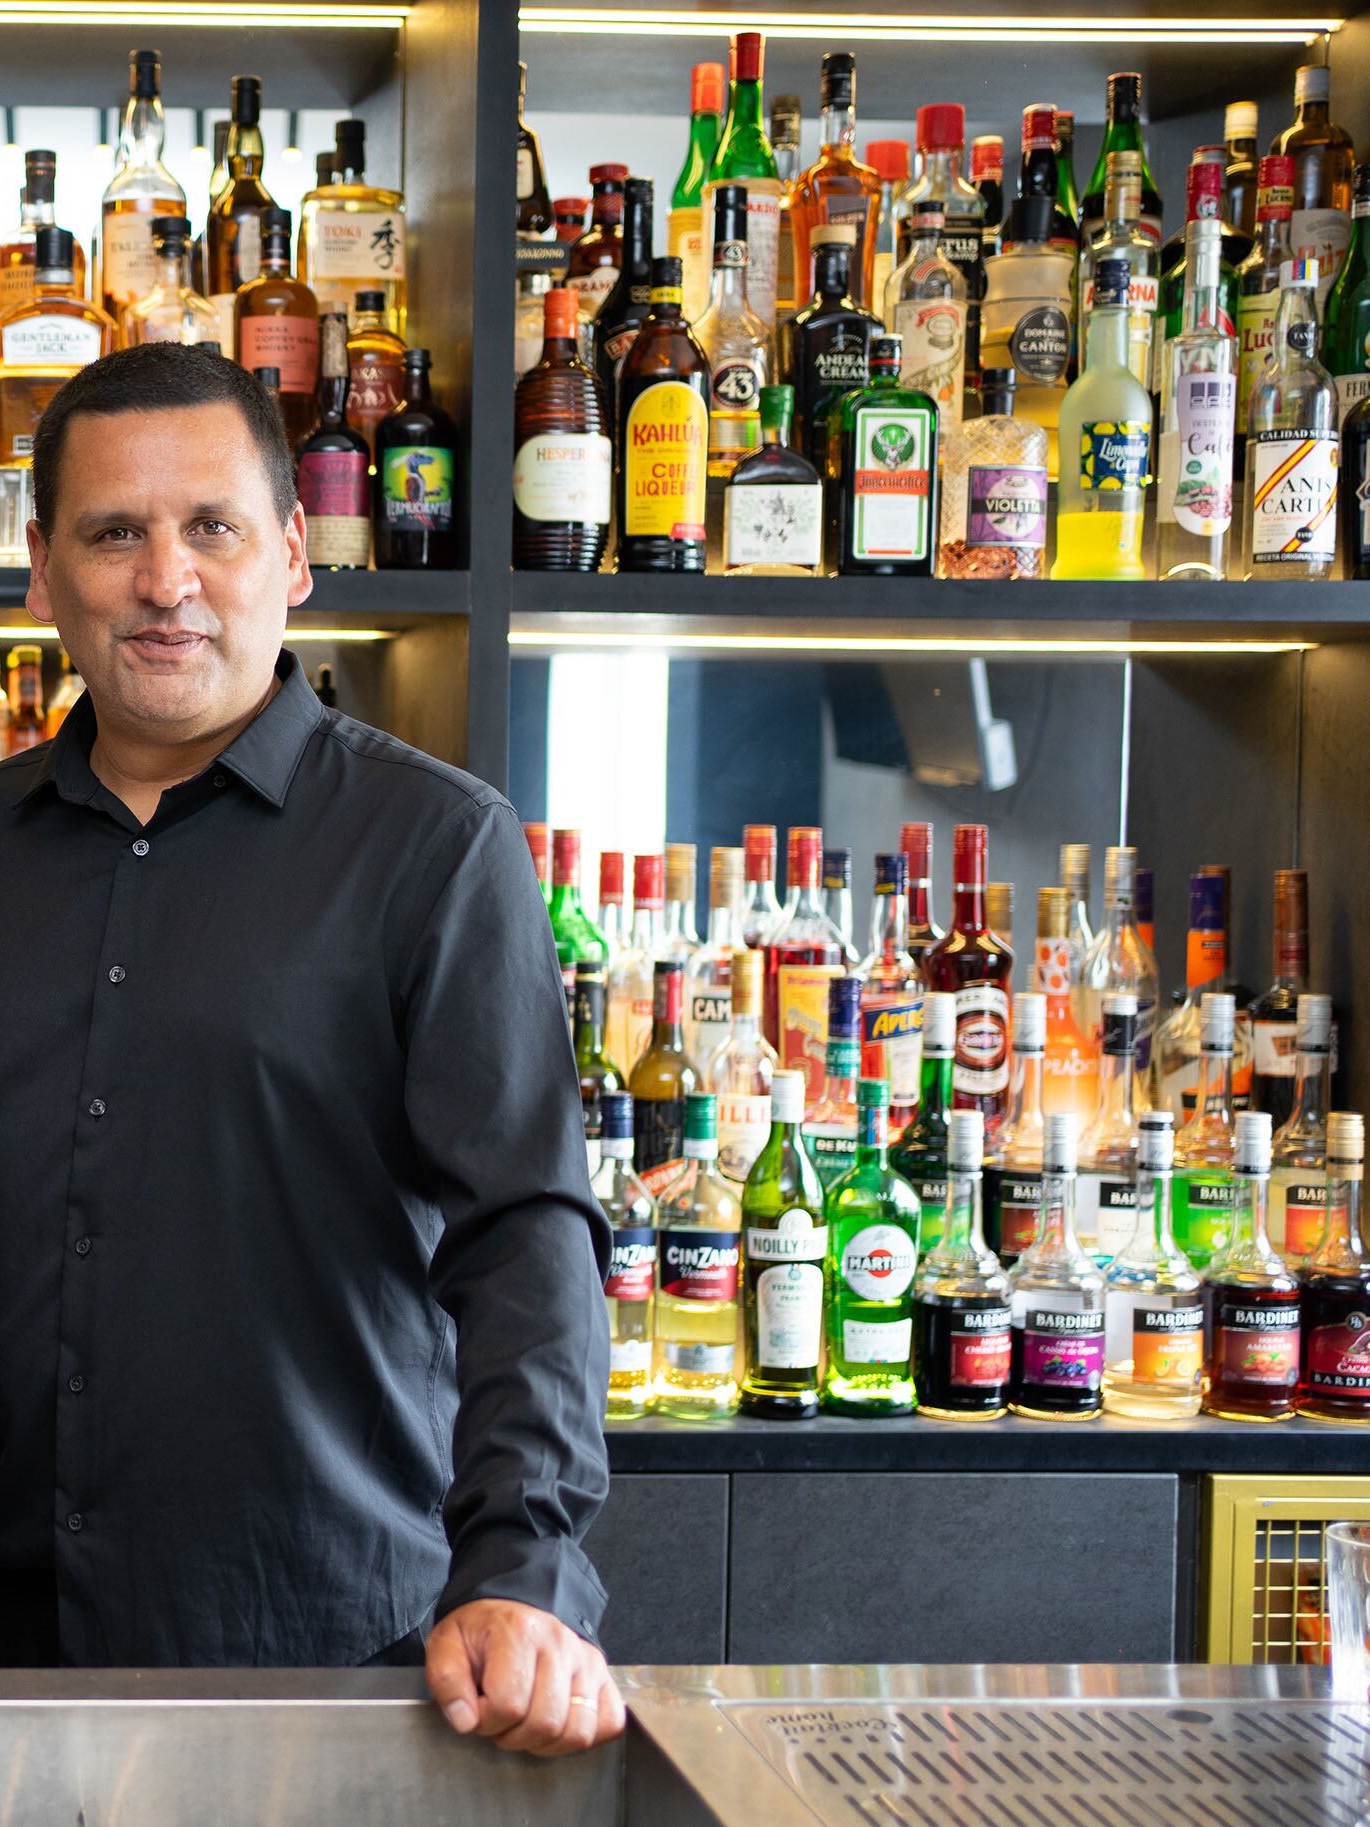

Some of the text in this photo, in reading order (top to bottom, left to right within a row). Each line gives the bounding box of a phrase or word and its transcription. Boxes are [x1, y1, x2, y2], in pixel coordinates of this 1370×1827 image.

[370, 217, 401, 270] 季
[11, 332, 91, 342] GENTLEMAN
[815, 354, 869, 368] ANDEA
[715, 364, 758, 399] 43
[1260, 430, 1306, 441] CALIDAD
[635, 480, 696, 497] LIQUEUR
[985, 499, 1041, 513] VIOLETTA
[753, 1236, 797, 1253] NOILLY
[666, 1245, 739, 1268] CINZANO
[964, 1313, 1012, 1328] BARDIN
[1036, 1313, 1103, 1329] BARDINET
[1235, 1311, 1299, 1326] BARDINET
[1313, 1374, 1370, 1388] BARDIN
